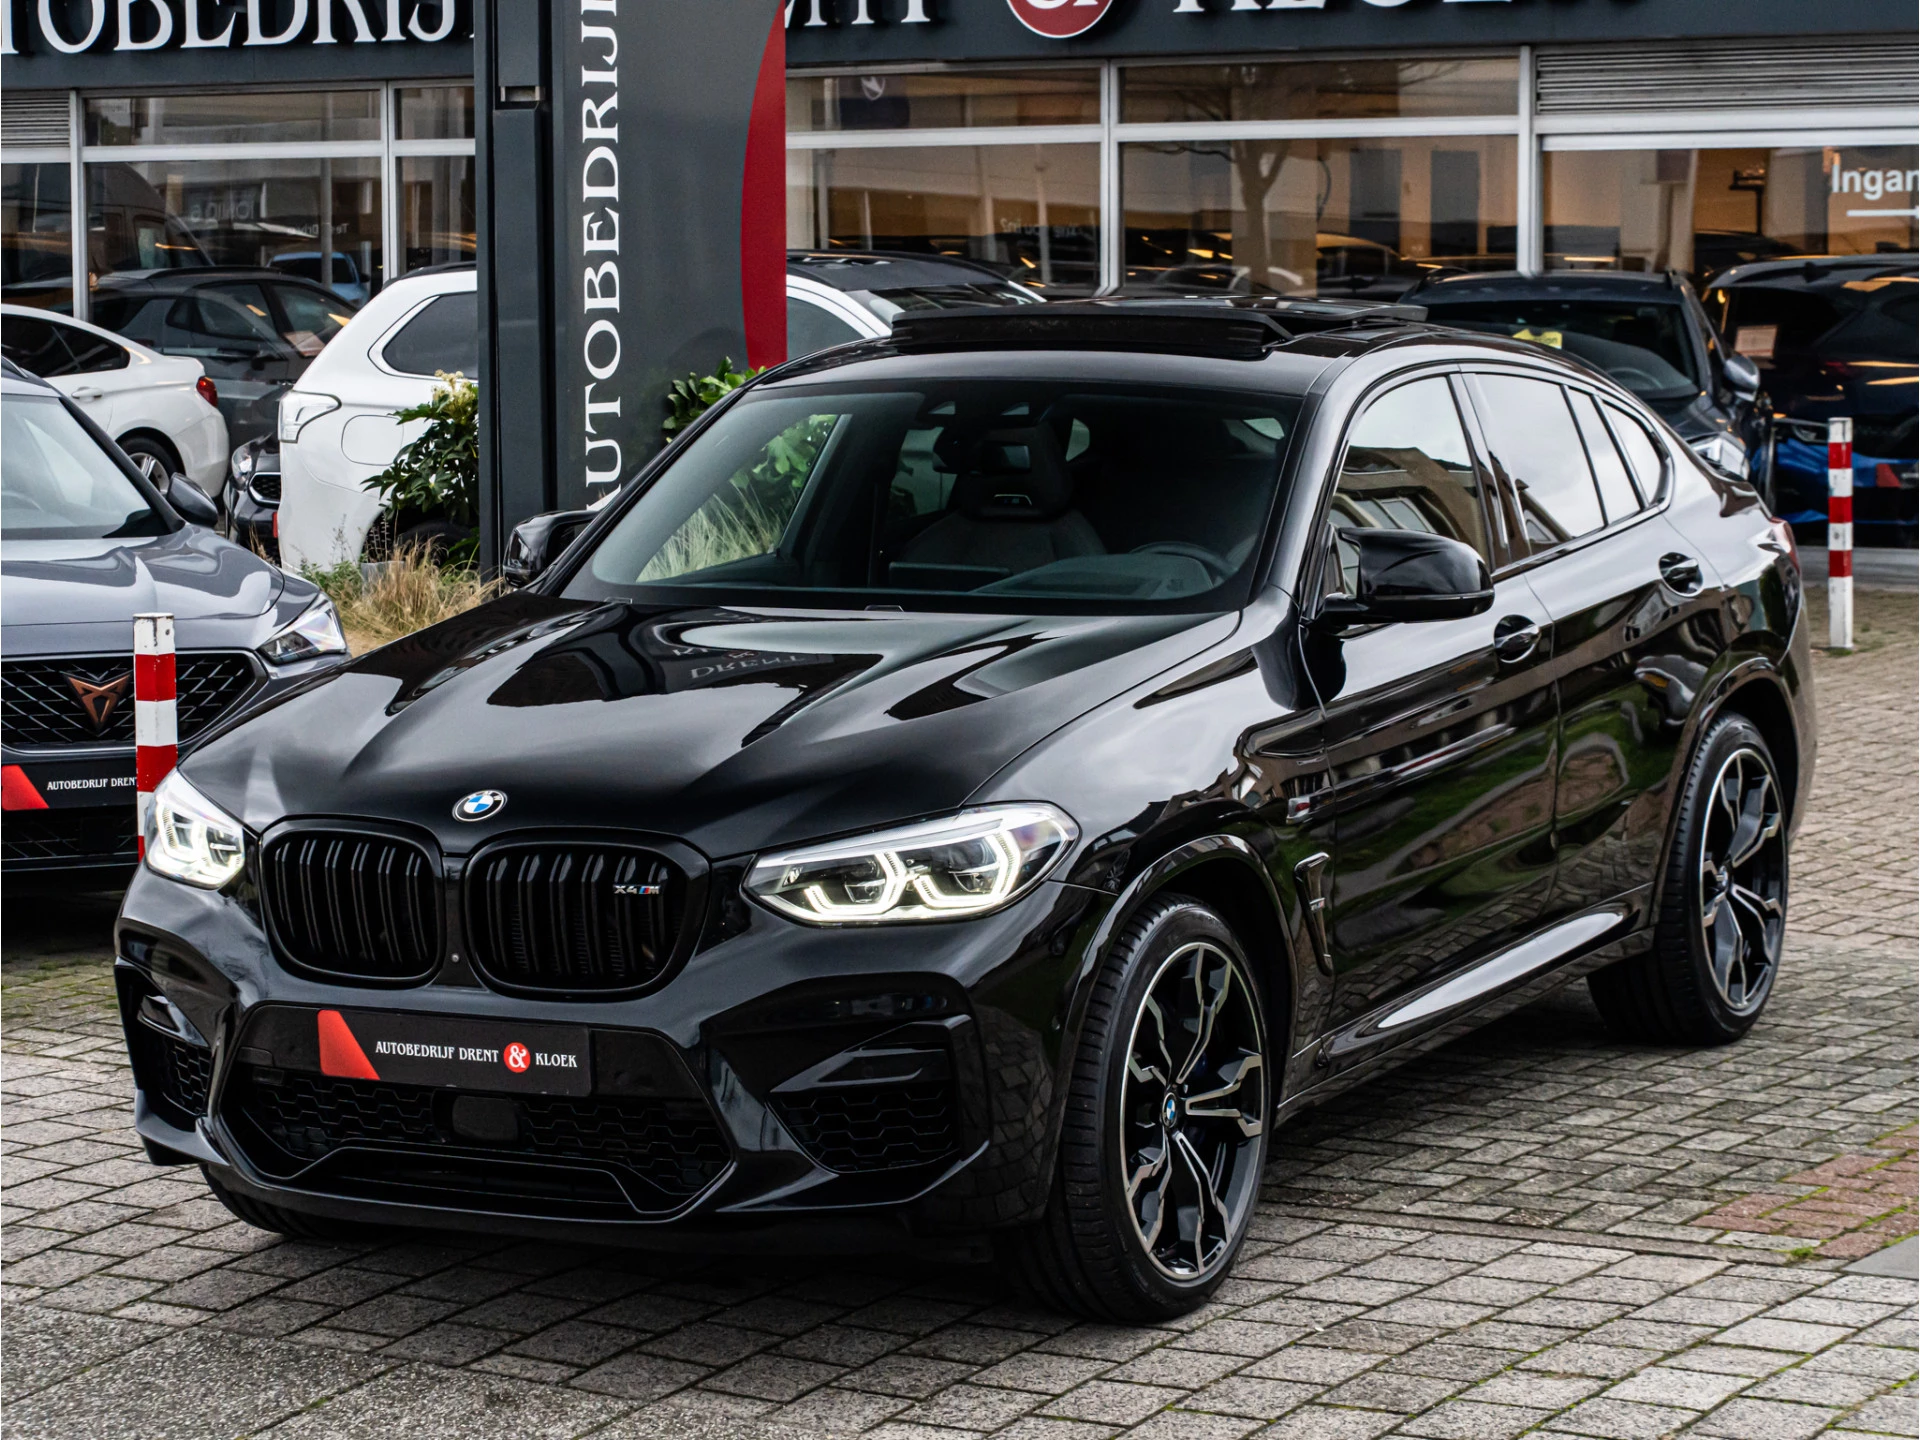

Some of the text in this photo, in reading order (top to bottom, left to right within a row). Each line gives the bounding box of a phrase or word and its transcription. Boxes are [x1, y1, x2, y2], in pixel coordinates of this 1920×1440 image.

[46, 778, 109, 791] AUTOBEDRIJF
[375, 1040, 578, 1069] AUTOBEDRIJF DRENT & KLOEK
